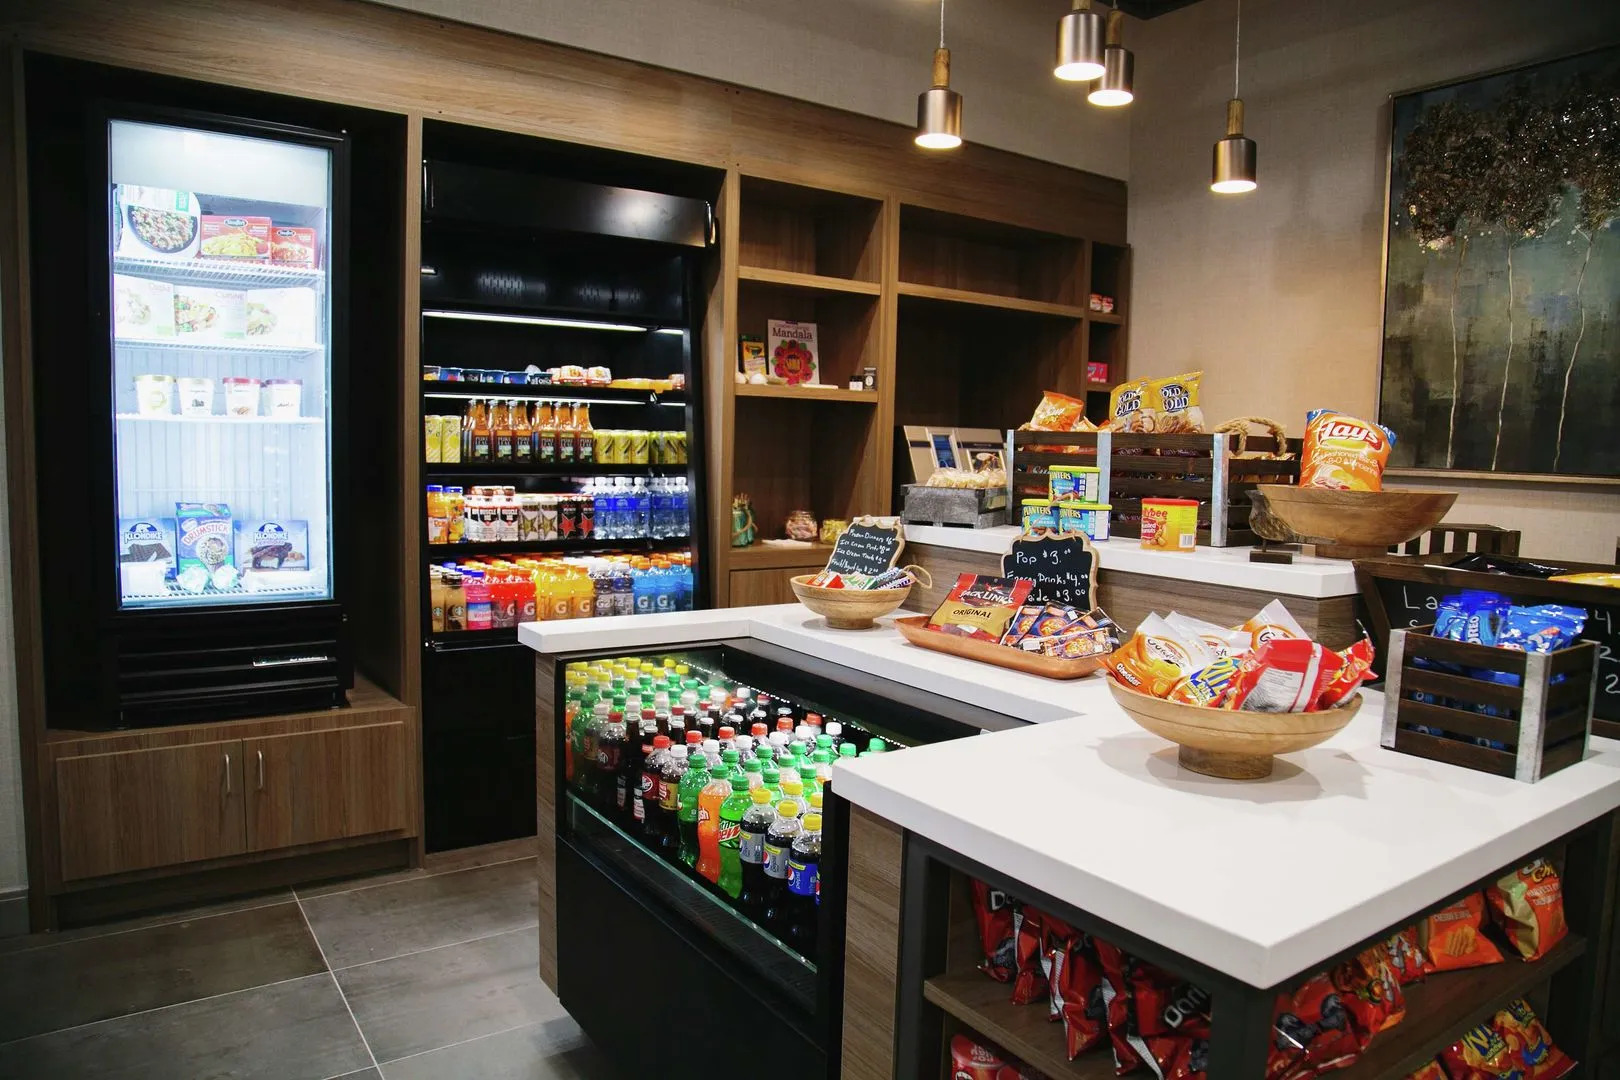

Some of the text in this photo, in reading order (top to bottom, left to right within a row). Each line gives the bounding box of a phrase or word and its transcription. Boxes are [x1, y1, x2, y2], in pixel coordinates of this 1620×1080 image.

[772, 327, 813, 340] Mandala
[124, 531, 163, 544] KLONDIKE
[182, 523, 230, 546] DRUMSTICK
[253, 532, 289, 543] KLONDIKE
[850, 541, 865, 549] Cream
[836, 547, 846, 555] Ice
[845, 549, 861, 557] Cream
[1016, 551, 1037, 564] Pop
[1037, 572, 1067, 585] Drinks
[580, 600, 590, 613] G
[637, 595, 649, 609] G
[657, 594, 668, 607] G
[523, 602, 535, 616] G
[555, 601, 567, 614] G
[953, 608, 992, 618] ORIGINAL
[1116, 662, 1142, 687] Cheddar
[1164, 987, 1208, 1028] Dori
